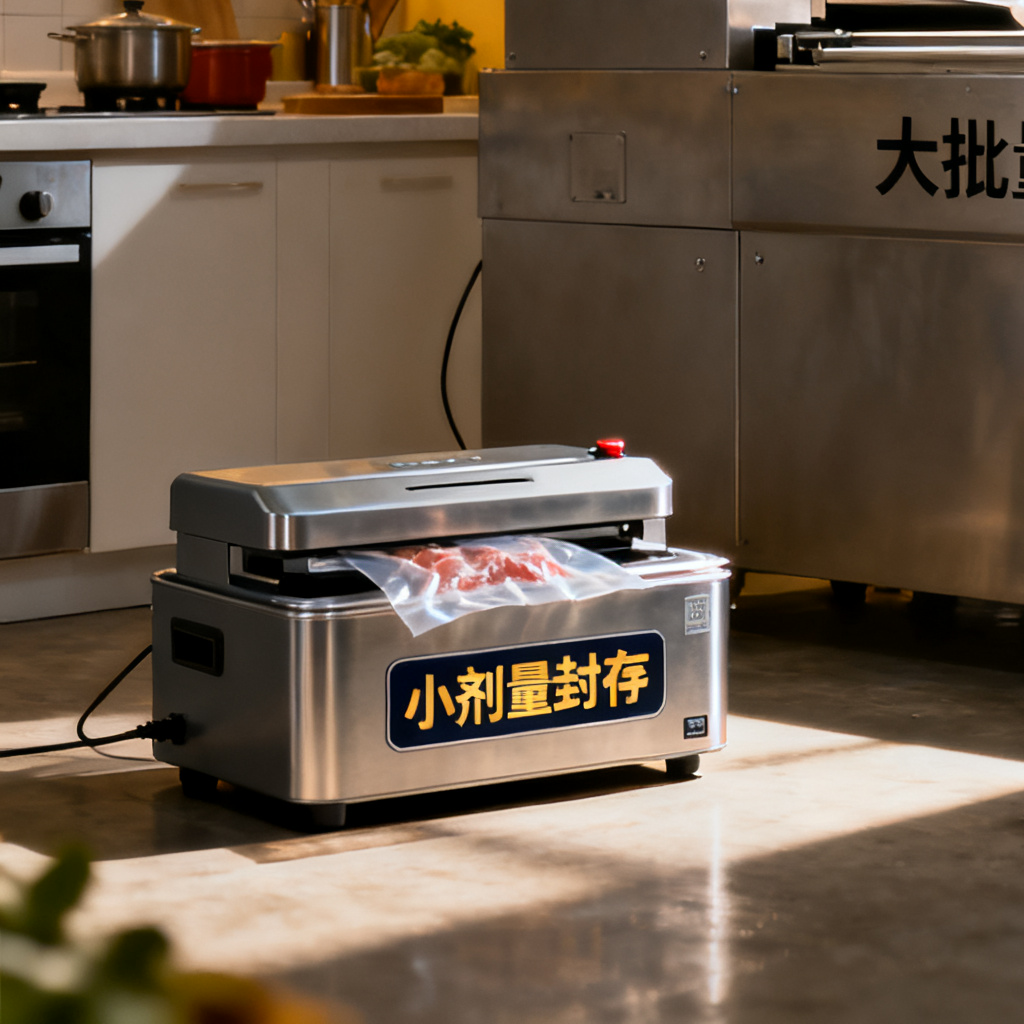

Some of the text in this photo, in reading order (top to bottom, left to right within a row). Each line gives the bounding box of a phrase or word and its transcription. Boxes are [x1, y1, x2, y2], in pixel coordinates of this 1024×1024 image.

[404, 649, 650, 730] 小剂量封存
